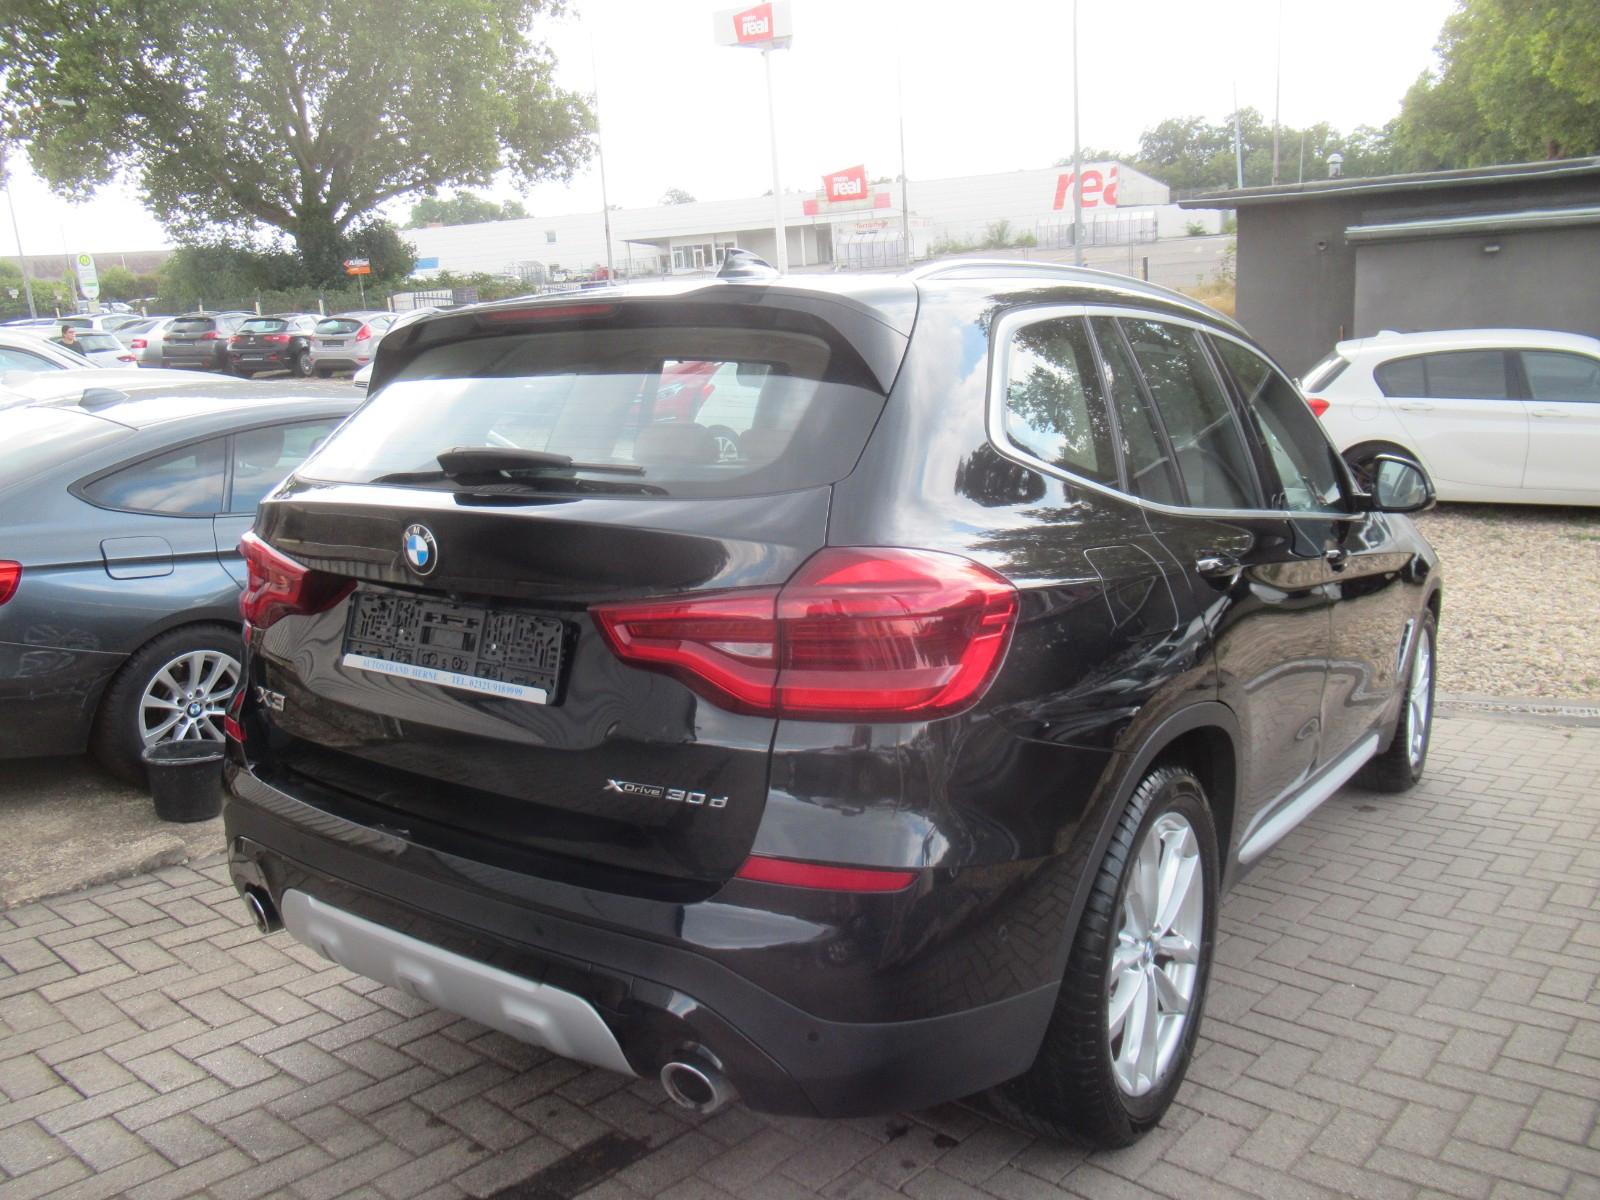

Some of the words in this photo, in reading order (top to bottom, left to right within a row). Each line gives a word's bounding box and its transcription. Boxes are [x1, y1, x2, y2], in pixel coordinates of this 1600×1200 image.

[742, 16, 769, 36] real
[833, 177, 862, 196] real
[257, 686, 286, 712] X3
